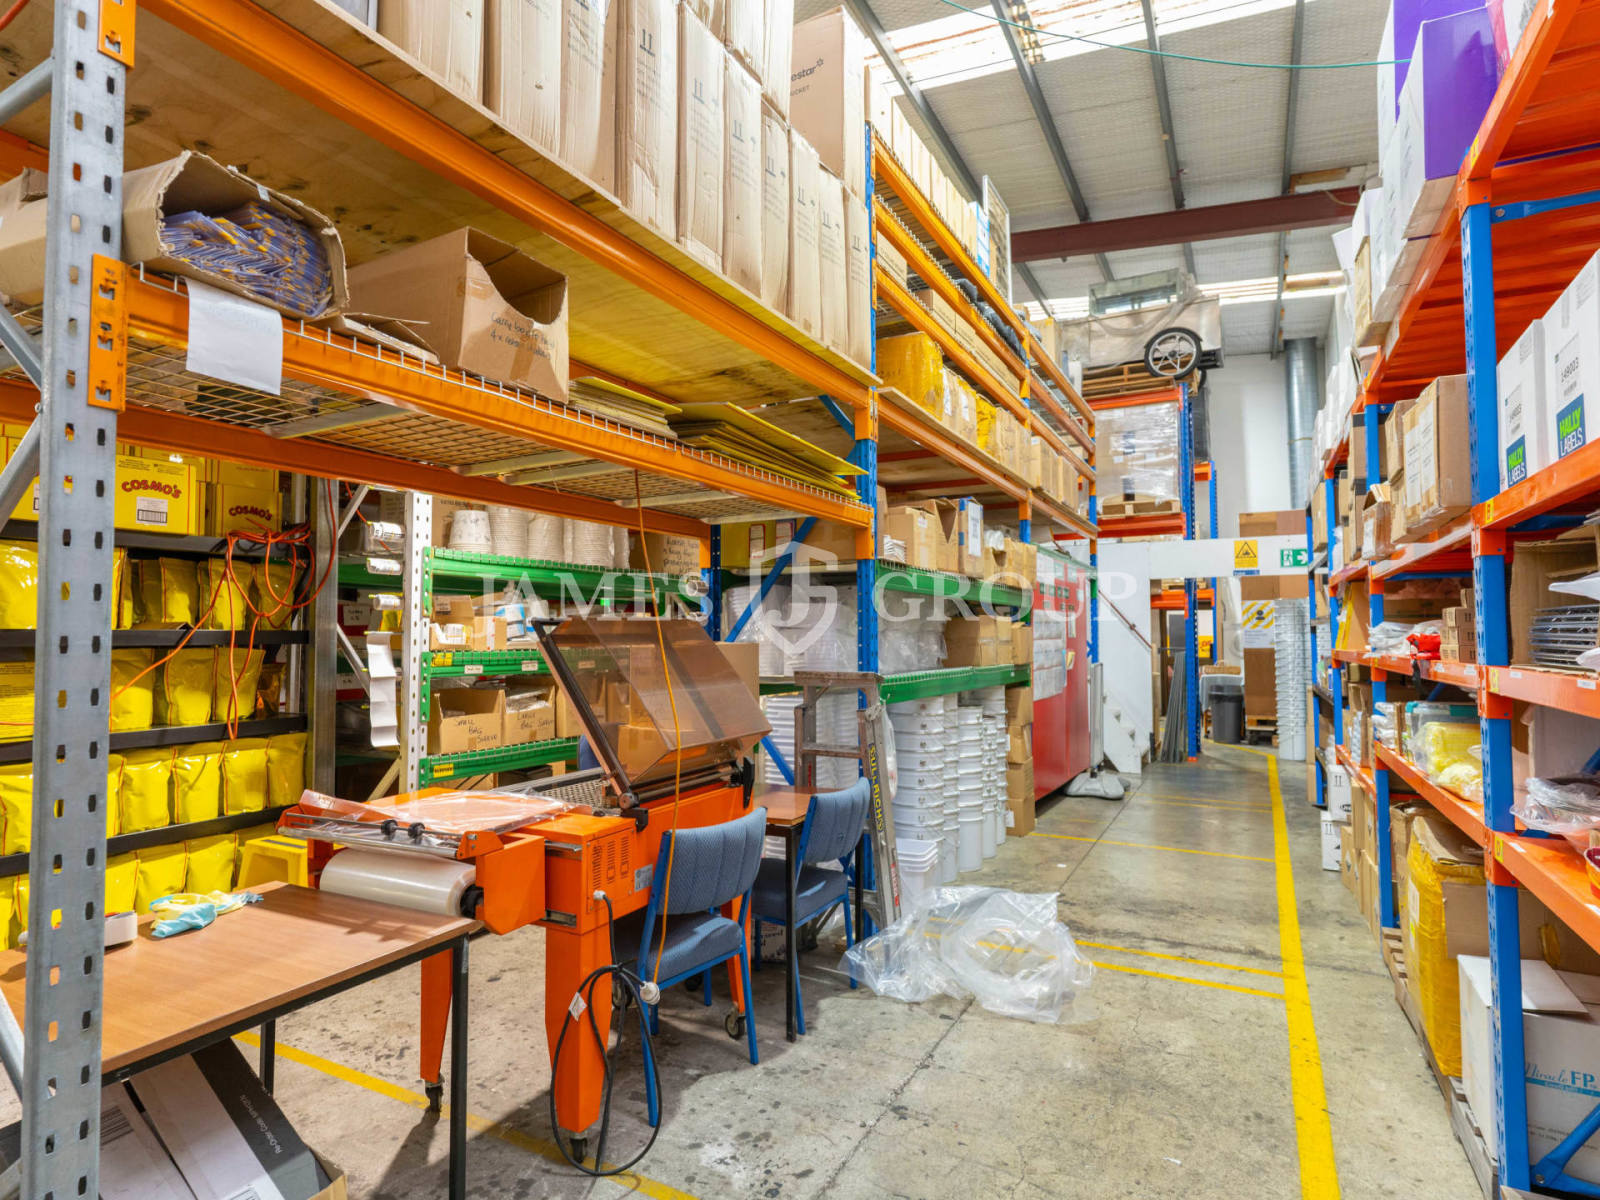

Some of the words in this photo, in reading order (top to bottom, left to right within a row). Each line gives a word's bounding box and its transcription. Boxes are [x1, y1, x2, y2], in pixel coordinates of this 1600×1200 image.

[791, 66, 817, 82] estar
[790, 84, 810, 97] UCKET
[1560, 407, 1582, 440] HALLY
[1560, 427, 1584, 457] LABELS
[121, 479, 183, 499] COSMO'S
[228, 505, 273, 522] COSMO'S
[1571, 1071, 1595, 1087] FP
